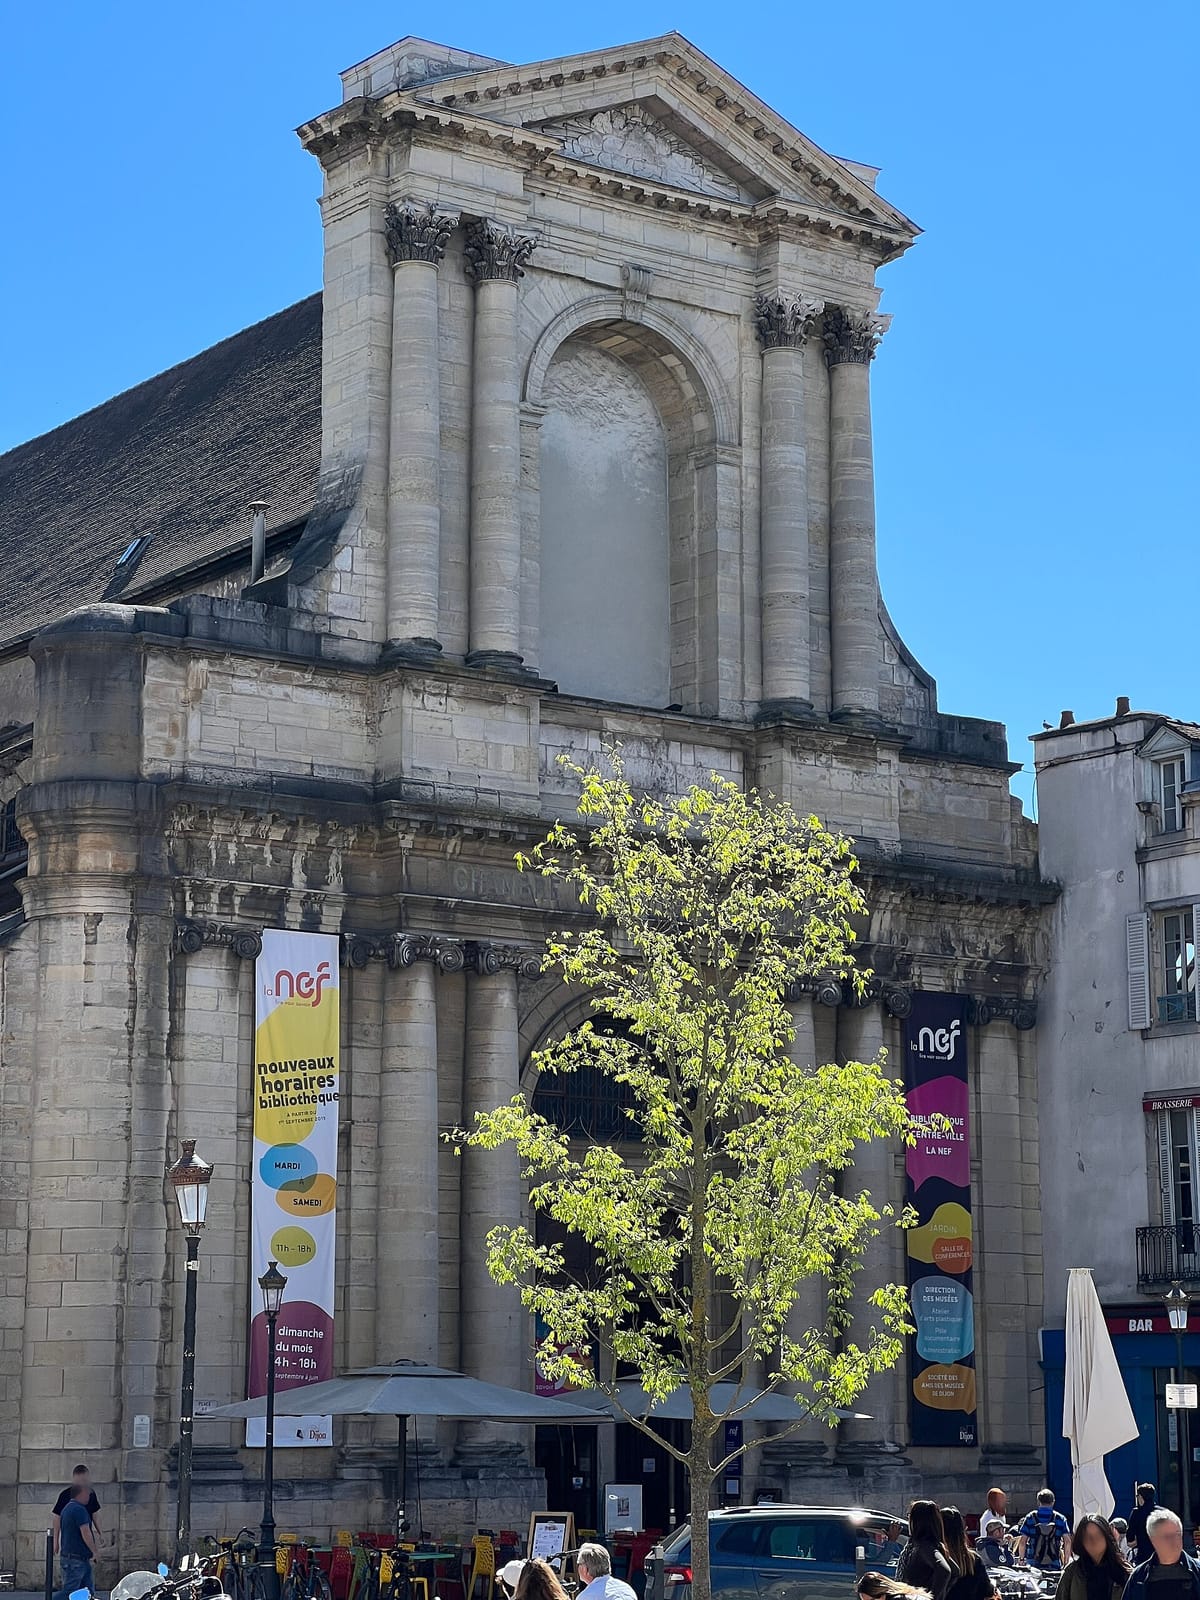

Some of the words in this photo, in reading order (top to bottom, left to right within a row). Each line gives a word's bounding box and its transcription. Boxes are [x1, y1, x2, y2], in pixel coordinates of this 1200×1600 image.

[275, 961, 331, 1008] nef
[910, 1040, 918, 1051] la
[919, 1019, 960, 1060] nef
[257, 1056, 335, 1075] nouveaux
[260, 1073, 335, 1094] horaires
[259, 1089, 339, 1110] bibliothèque
[1152, 1098, 1193, 1110] BRASSERIE
[285, 1117, 313, 1125] SEPTEMBRE
[911, 1130, 965, 1141] CENTRE-VILLE
[925, 1146, 936, 1155] LA
[937, 1147, 952, 1156] NEF
[274, 1162, 301, 1170] MARDI
[292, 1198, 322, 1207] SAMEDI
[929, 1224, 957, 1234] JARDIN
[925, 1286, 956, 1294] DIRECTION
[935, 1295, 959, 1303] MUSÉES
[1128, 1319, 1153, 1332] BAR
[278, 1325, 324, 1339] dimanche
[275, 1341, 289, 1352] du
[291, 1343, 313, 1353] mois
[274, 1356, 289, 1367] 4h
[309, 1429, 327, 1442] Dijon
[959, 1431, 974, 1442] Dijon
